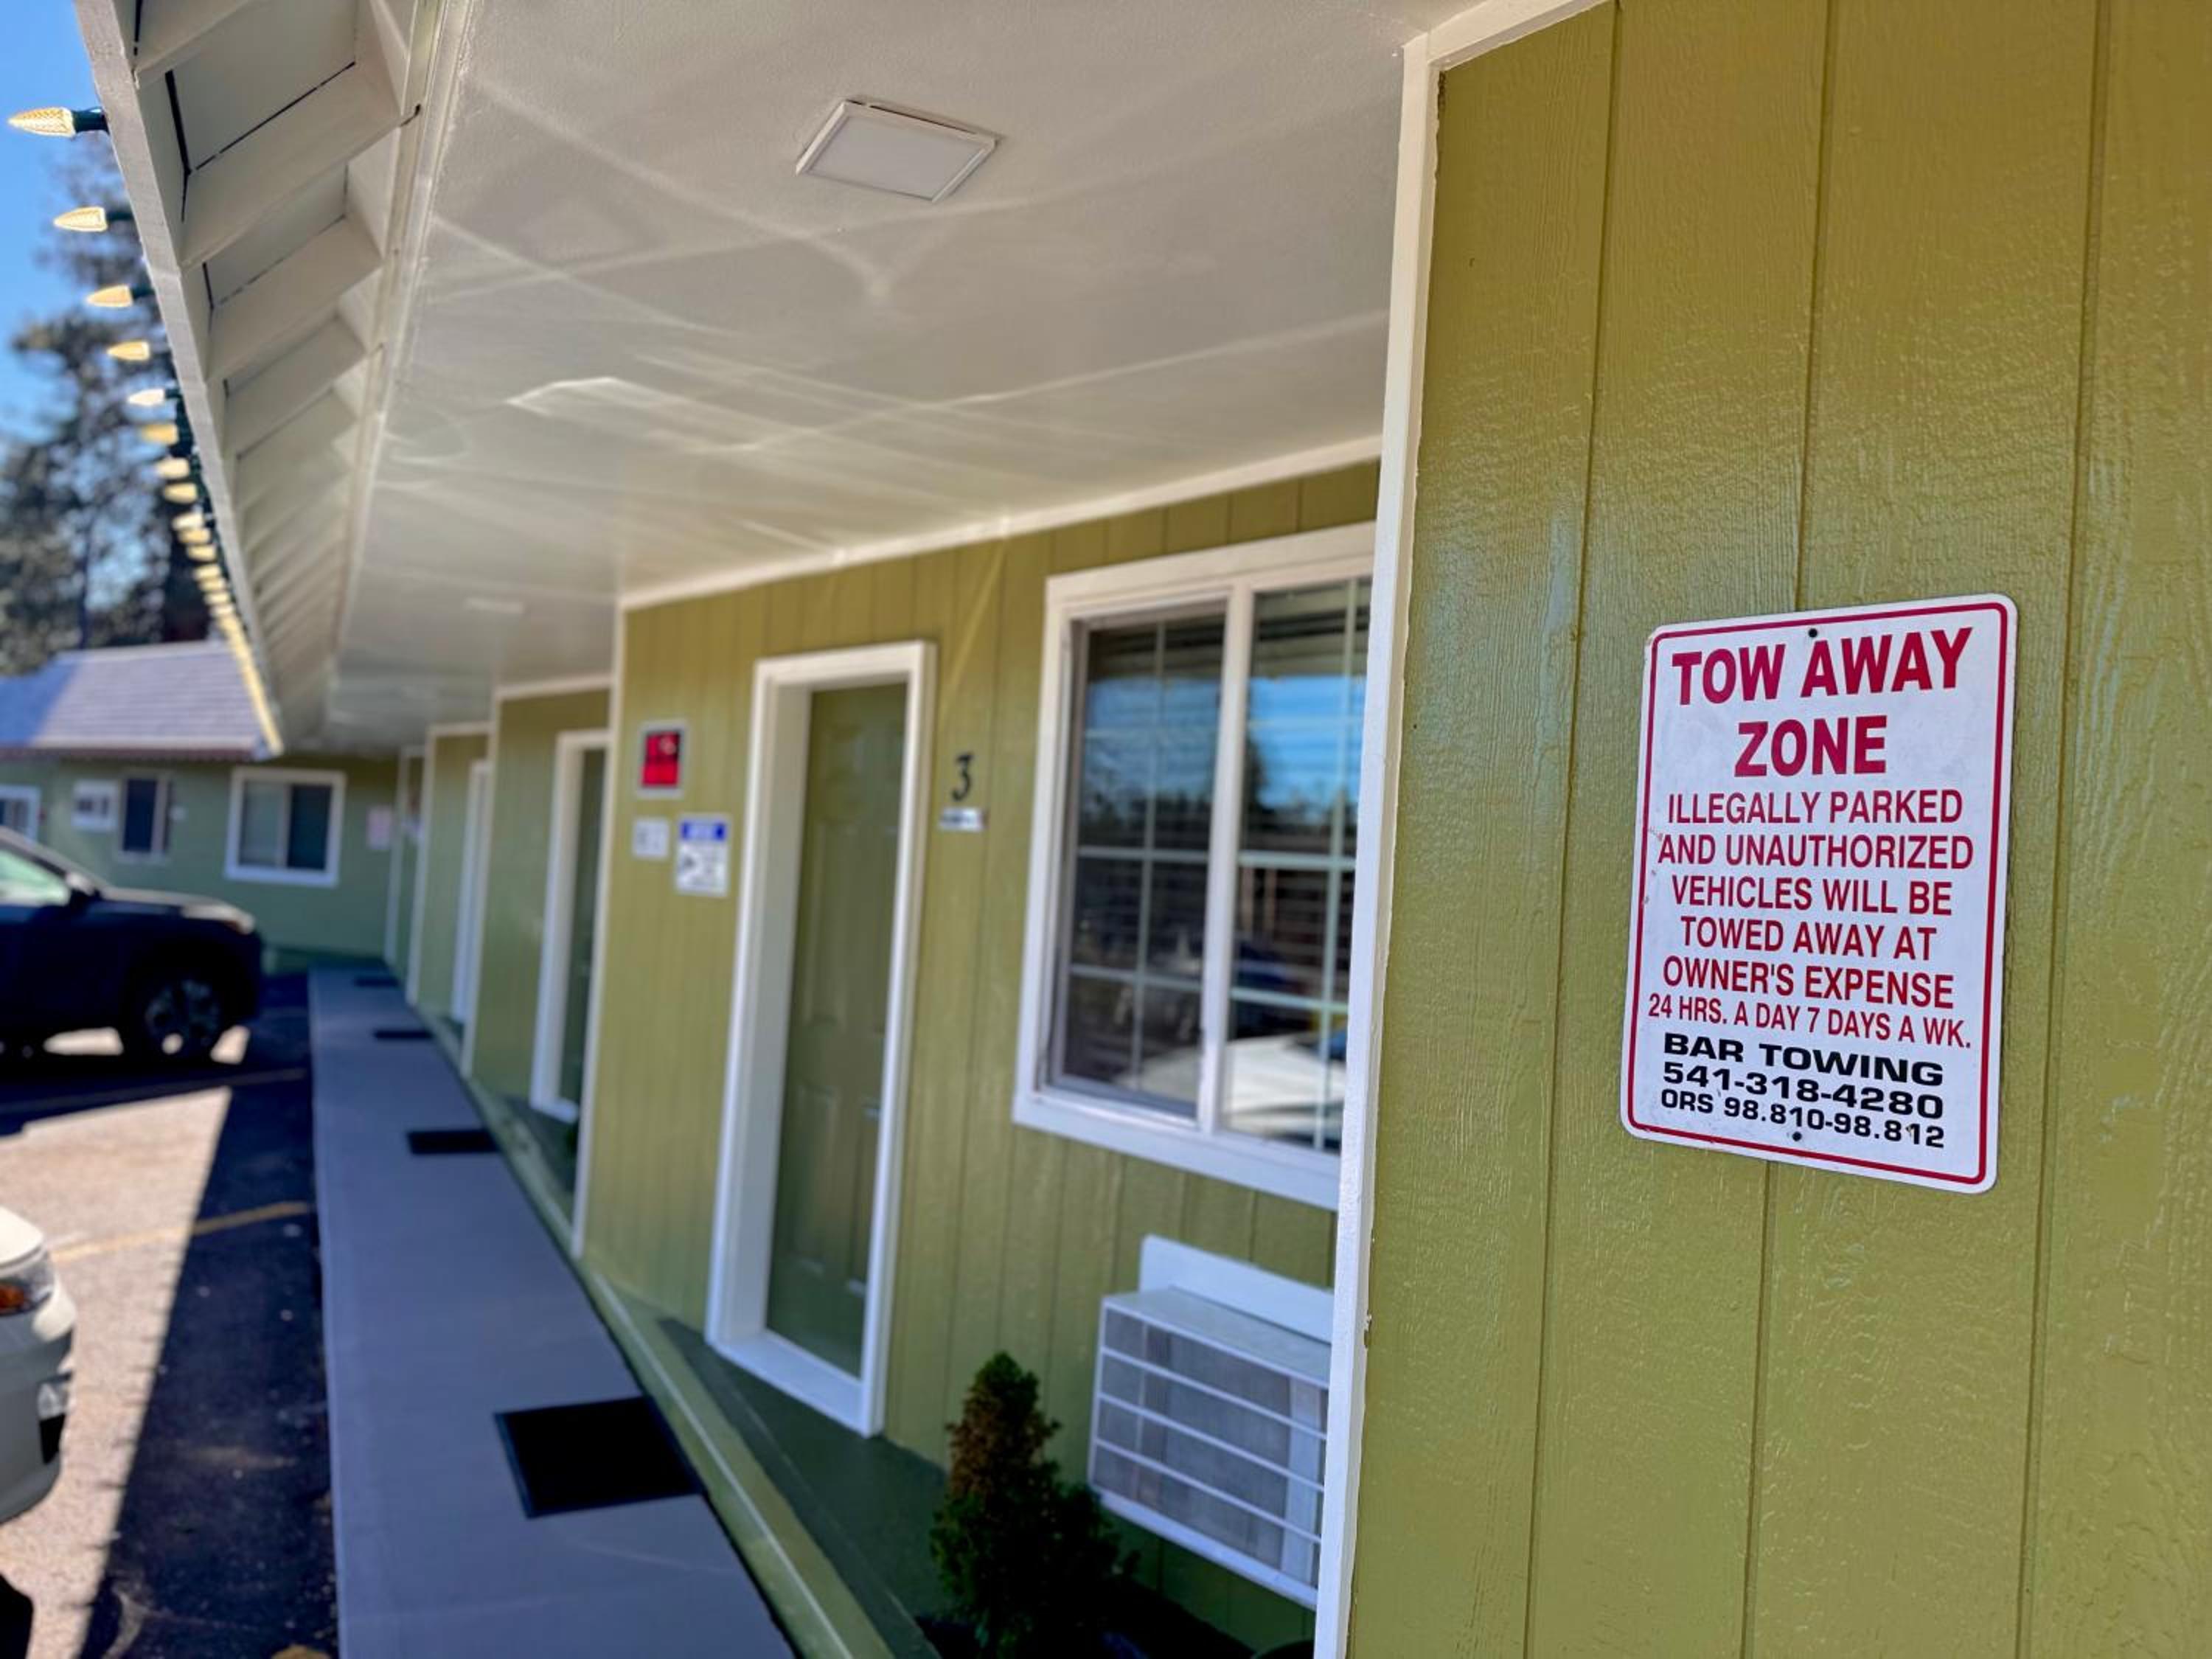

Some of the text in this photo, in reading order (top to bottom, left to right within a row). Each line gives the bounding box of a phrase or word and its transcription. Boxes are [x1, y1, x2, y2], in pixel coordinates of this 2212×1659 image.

[1672, 627, 1973, 706] TOW AWAY
[1734, 715, 1887, 777] ZONE
[952, 752, 973, 801] 3
[1668, 789, 1962, 824] ILLEGALLY PARKED
[1658, 835, 1974, 869] AND UNAUTHORIZED
[1672, 874, 1952, 916] VEHICLES WILL BE
[1680, 916, 1937, 961] TOWED AWAY AT
[1663, 956, 1954, 1009] OWNER'S EXPENSE
[1648, 993, 1970, 1048] 24 HRS. A DAY 7 DAYS A WK.
[1664, 1032, 1944, 1085] BAR TOWING
[1663, 1062, 1944, 1119] 541-318-4280
[1661, 1088, 1944, 1148] ORS 98.810-98.812
